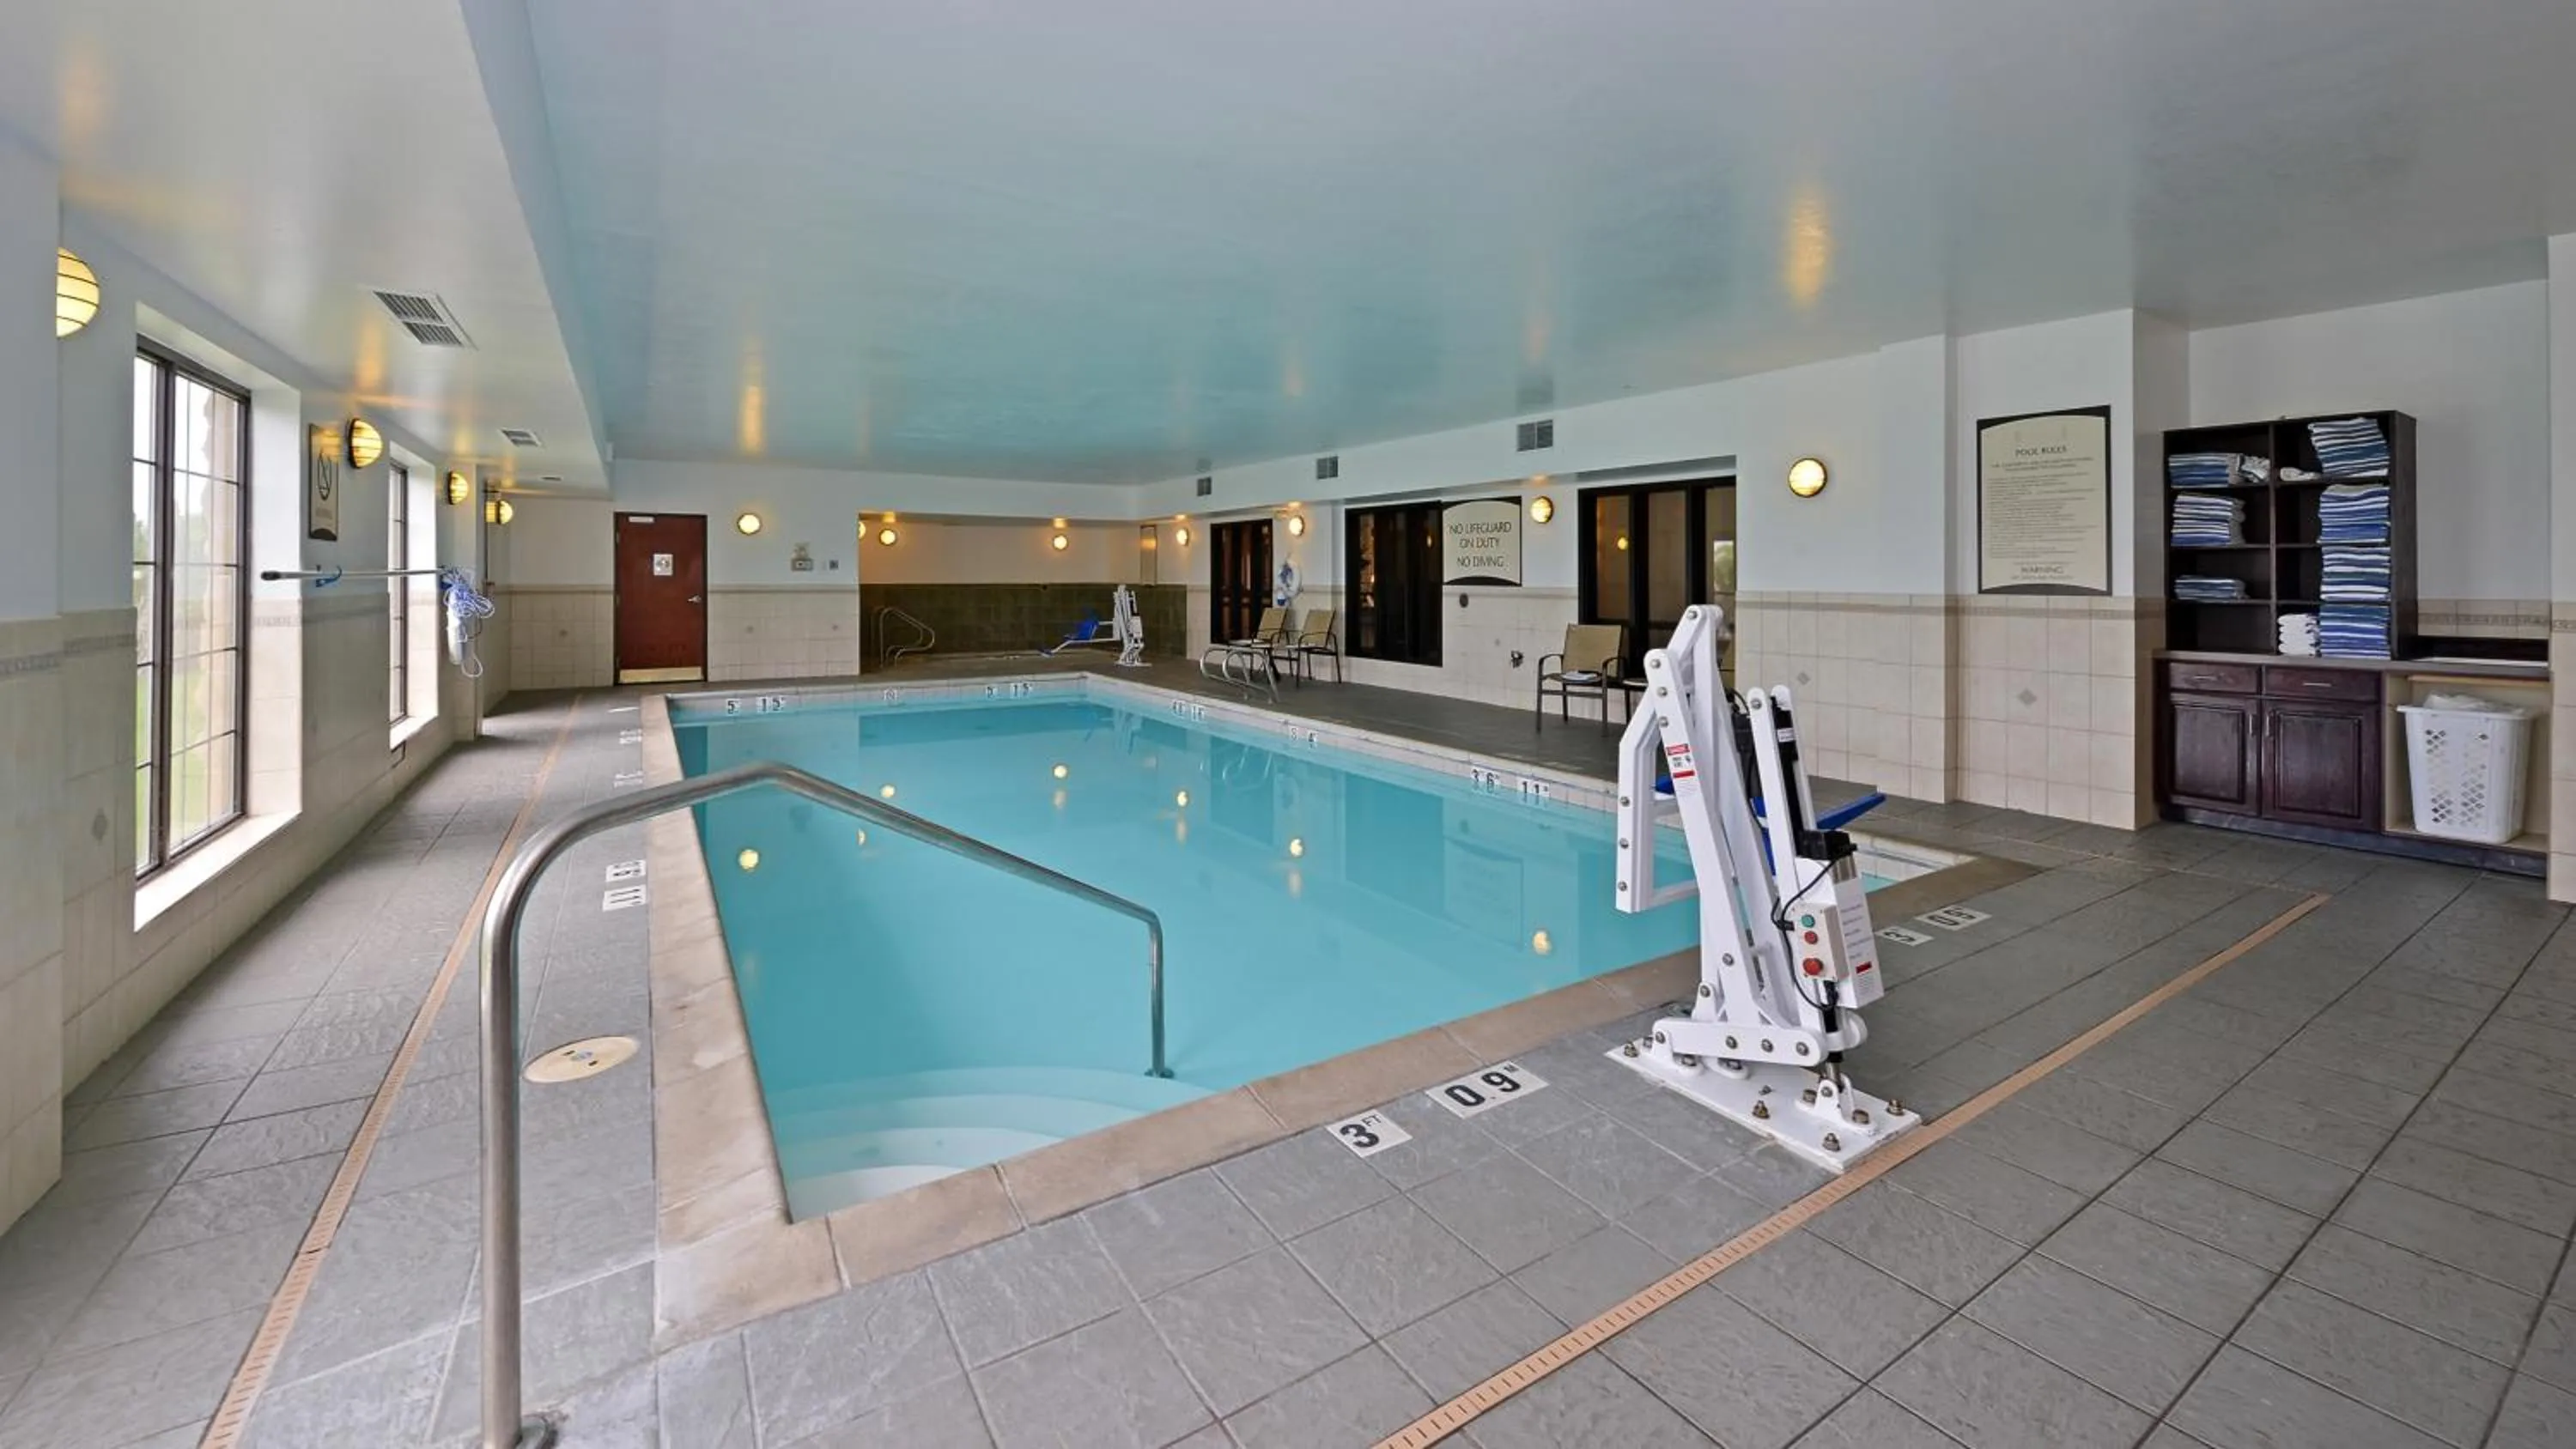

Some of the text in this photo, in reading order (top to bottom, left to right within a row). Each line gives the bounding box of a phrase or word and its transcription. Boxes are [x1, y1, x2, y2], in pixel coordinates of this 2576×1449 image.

[1449, 521, 1512, 534] NO LIFEGUARD
[1459, 537, 1499, 548] ON DUTY
[1457, 556, 1504, 567] NO DIVING
